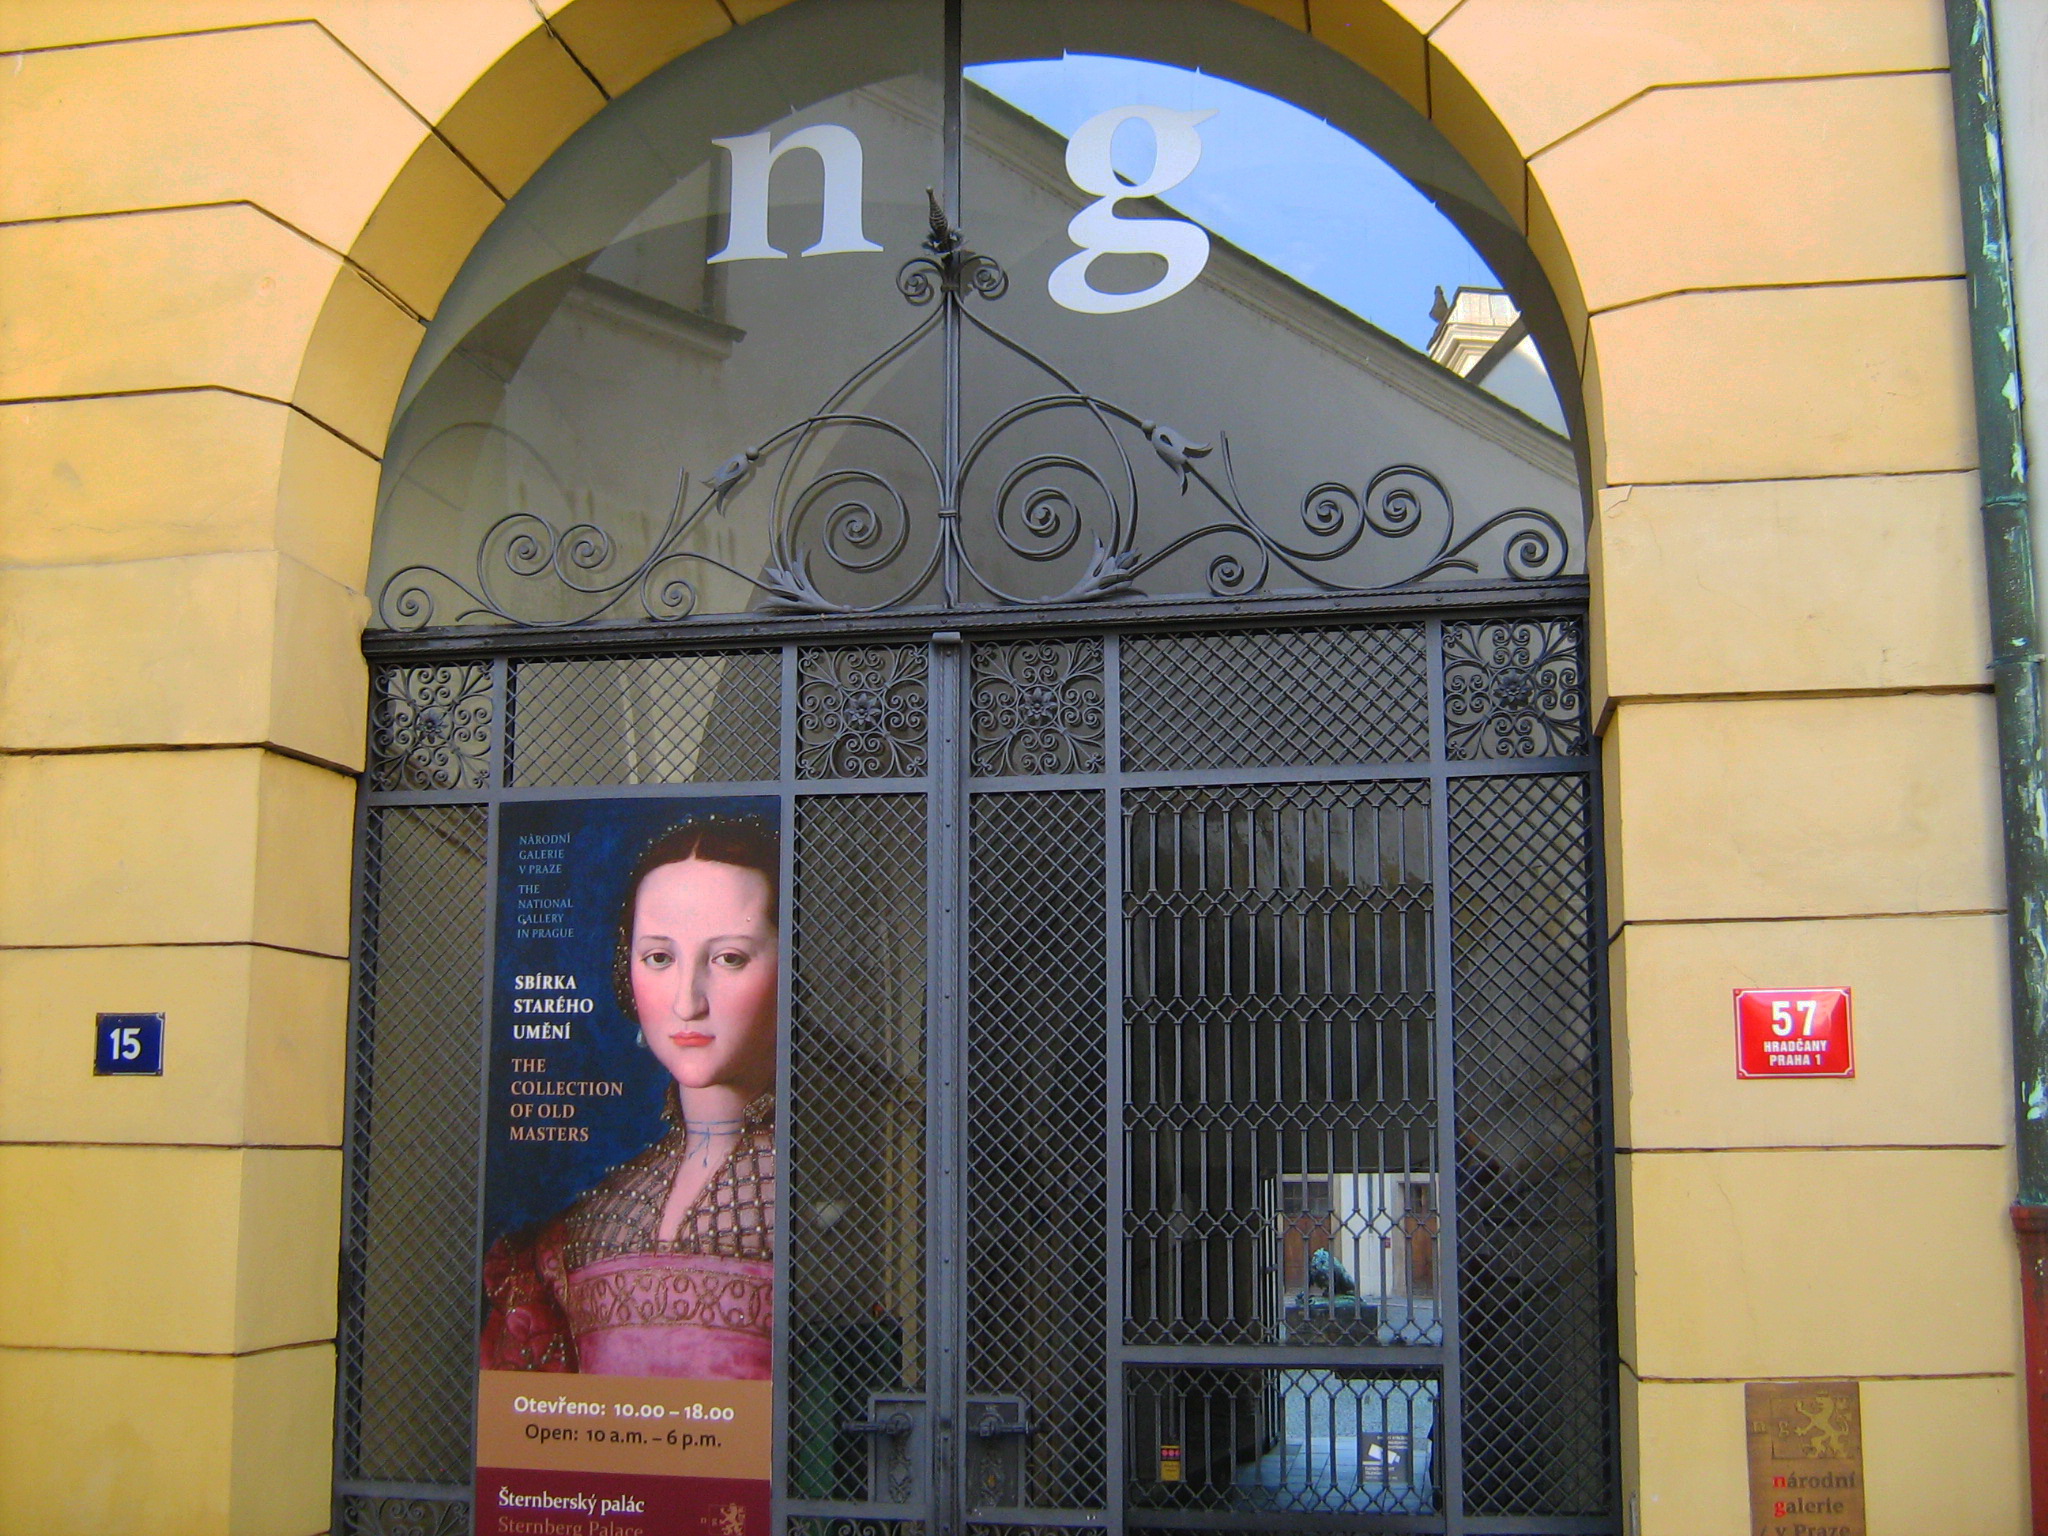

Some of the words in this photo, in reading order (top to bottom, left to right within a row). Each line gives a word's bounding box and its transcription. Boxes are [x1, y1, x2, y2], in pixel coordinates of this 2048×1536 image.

[706, 123, 884, 264] n
[1047, 104, 1220, 314] g
[518, 832, 571, 845] NÁRODNÍ
[518, 849, 565, 860] GALERIE
[518, 865, 526, 874] V
[529, 864, 562, 874] PRAZE
[518, 884, 540, 894] THE
[518, 898, 573, 909] NATIONAL
[517, 913, 564, 925] GALLERY
[517, 929, 529, 938] IN
[532, 928, 574, 938] PRAGUE
[514, 972, 577, 990] SBÍRKA
[513, 996, 594, 1014] STARÉHO
[1771, 1000, 1818, 1036] 57
[512, 1022, 571, 1039] UMĚNÍ
[109, 1027, 141, 1060] 15
[1763, 1038, 1828, 1052] HRADČANY
[511, 1058, 546, 1073] THE
[1769, 1054, 1811, 1066] PRAHA
[1815, 1053, 1822, 1065] 1
[511, 1081, 623, 1096] COLLECTION
[510, 1104, 533, 1118] OF
[537, 1104, 575, 1118] OLD
[510, 1126, 590, 1142] MASTERS
[514, 1396, 606, 1416] Otevřeno:
[614, 1403, 665, 1419] 10.00
[684, 1403, 735, 1421] 18.00
[525, 1424, 578, 1444] Open:
[587, 1430, 605, 1443] 10
[610, 1430, 648, 1445] a.m.
[667, 1429, 677, 1446] 6
[682, 1433, 722, 1450] p.m.
[1773, 1471, 1855, 1489] národní
[499, 1486, 597, 1515] Šternberský
[601, 1495, 645, 1515] palác
[1774, 1498, 1844, 1518] galerie
[498, 1516, 582, 1536] Sternberg
[589, 1521, 643, 1536] Palace
